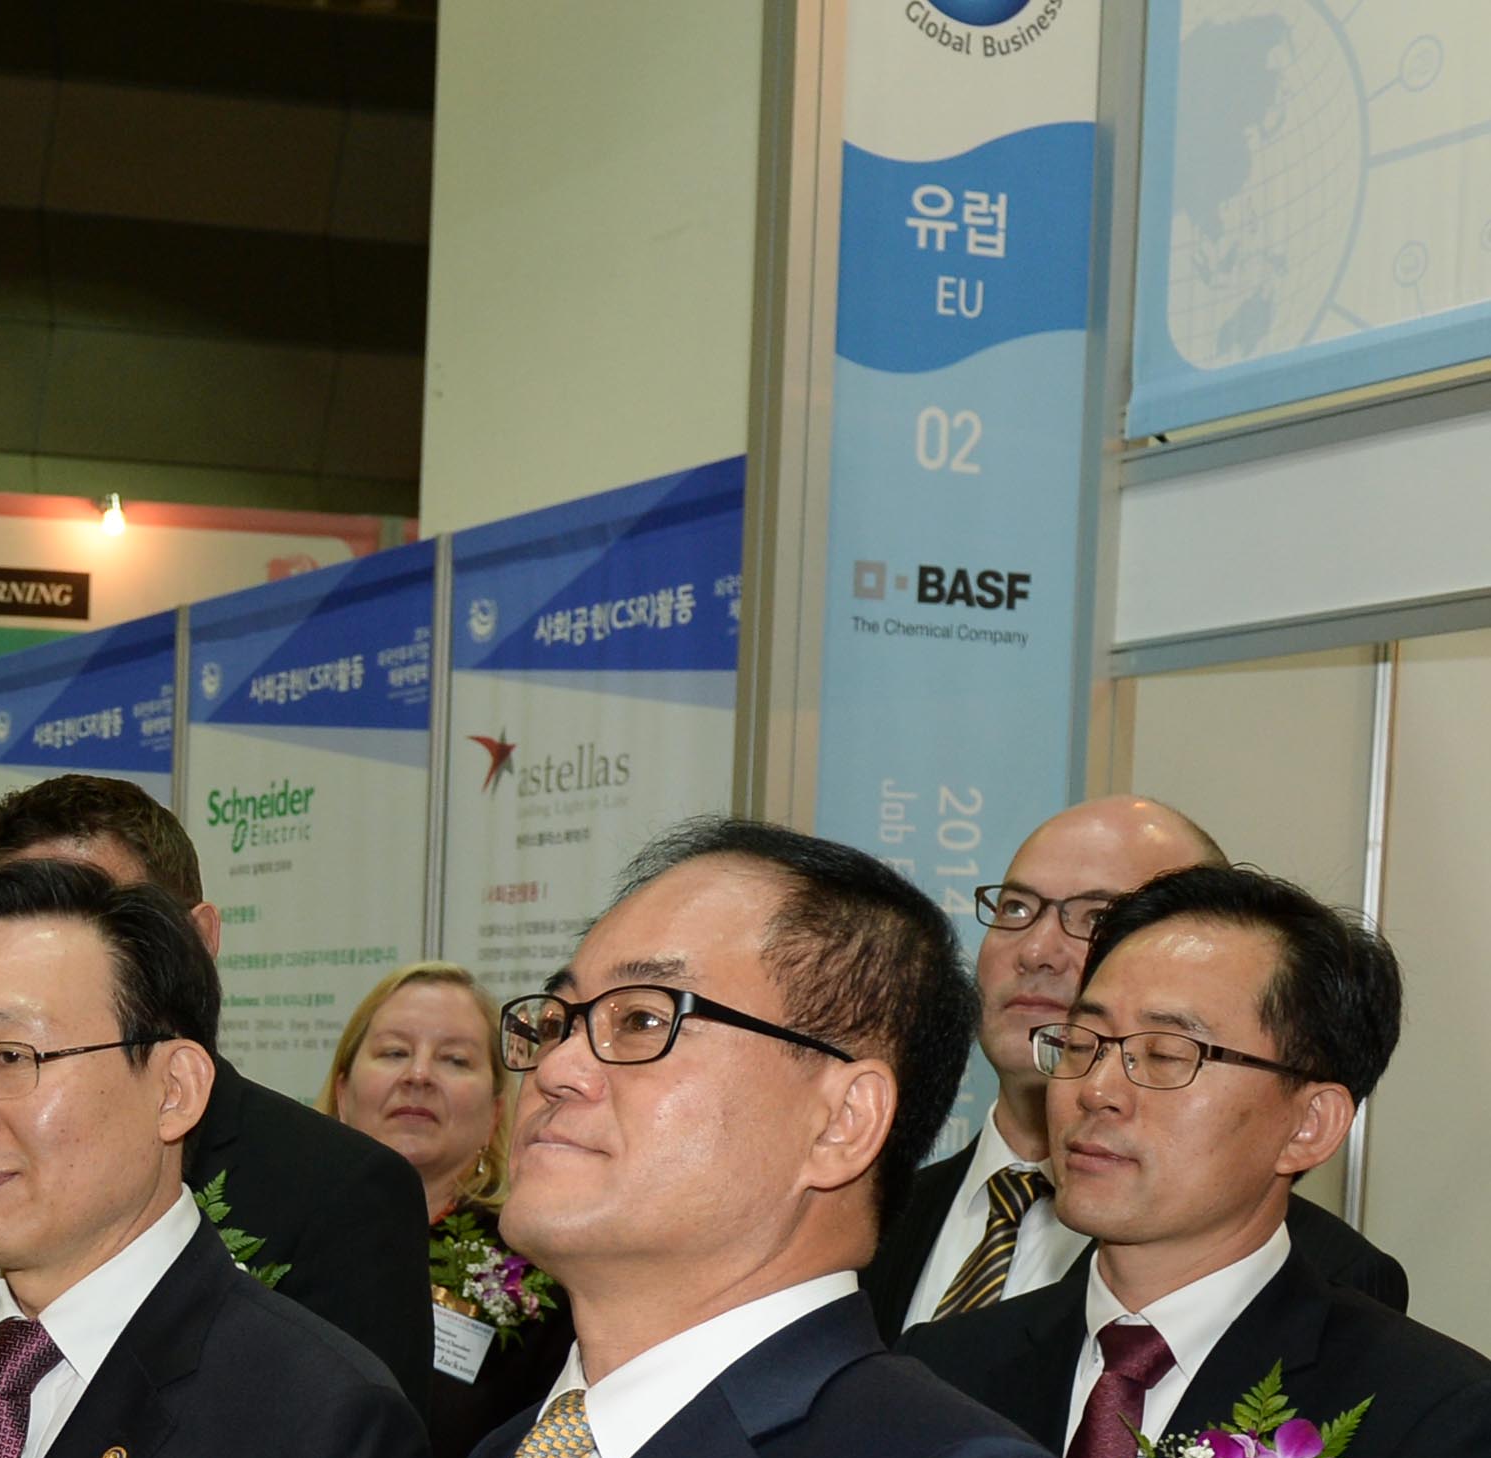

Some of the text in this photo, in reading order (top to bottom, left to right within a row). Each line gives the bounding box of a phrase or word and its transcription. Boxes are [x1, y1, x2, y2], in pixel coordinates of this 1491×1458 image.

[905, 0, 1063, 57] Global Business
[906, 183, 1008, 260] 유럽
[935, 275, 986, 319] EU
[914, 406, 983, 475] 02
[917, 564, 1032, 611] BASF
[852, 615, 1029, 648] The Chemical Company
[518, 743, 632, 797] astellas
[207, 779, 315, 827] Schneider
[879, 778, 918, 844] Job
[250, 823, 312, 847] Electric
[936, 785, 984, 915] 2014
